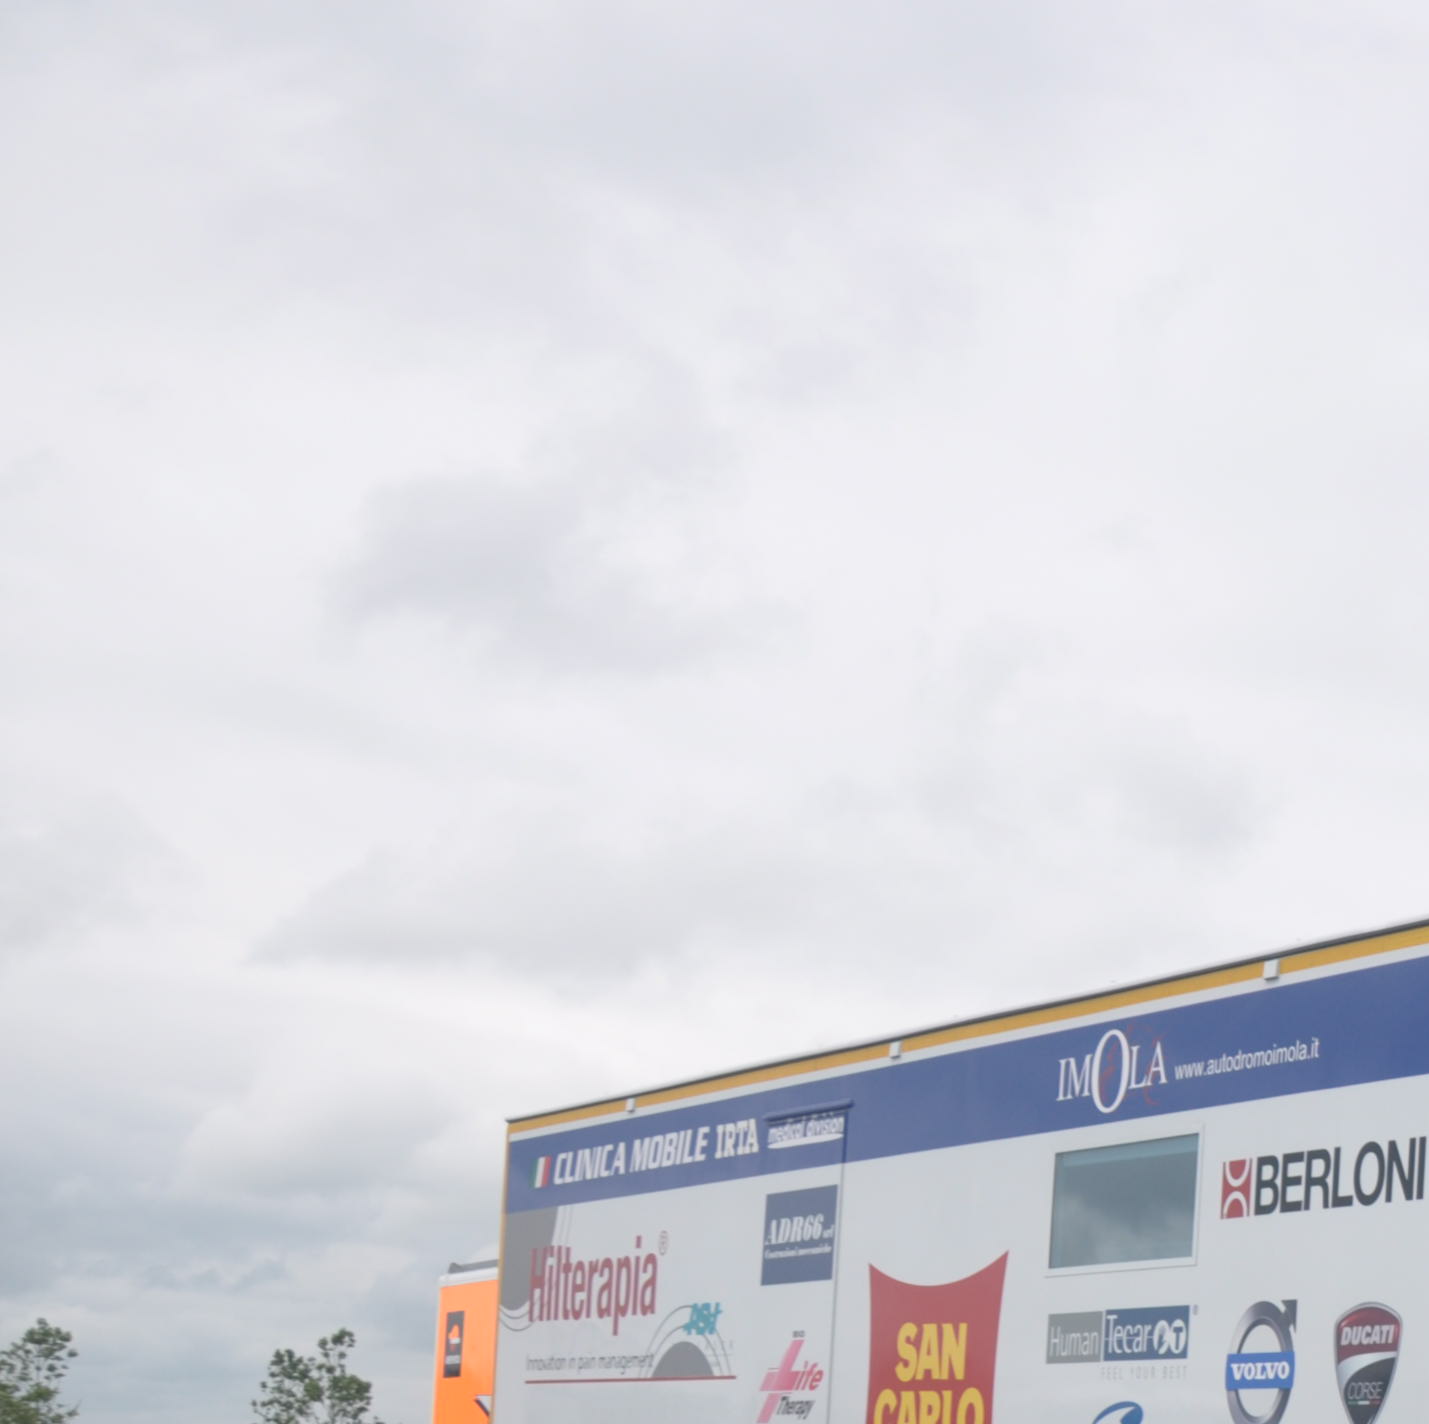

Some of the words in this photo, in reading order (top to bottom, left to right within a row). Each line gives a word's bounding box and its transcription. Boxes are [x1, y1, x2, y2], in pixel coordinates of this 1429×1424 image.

[1055, 1028, 1168, 1114] IMOLA
[553, 1144, 626, 1185] CLINICA
[629, 1126, 710, 1172] MOBILE
[714, 1117, 760, 1159] IRTA
[1253, 1135, 1428, 1217] BERLONI
[528, 1235, 659, 1336] Hilterapia
[894, 1322, 968, 1382] SAN
[1049, 1325, 1099, 1357] Human
[1340, 1324, 1396, 1346] DUCATI
[1230, 1360, 1290, 1381] VOLVO
[1347, 1381, 1385, 1400] CORSE
